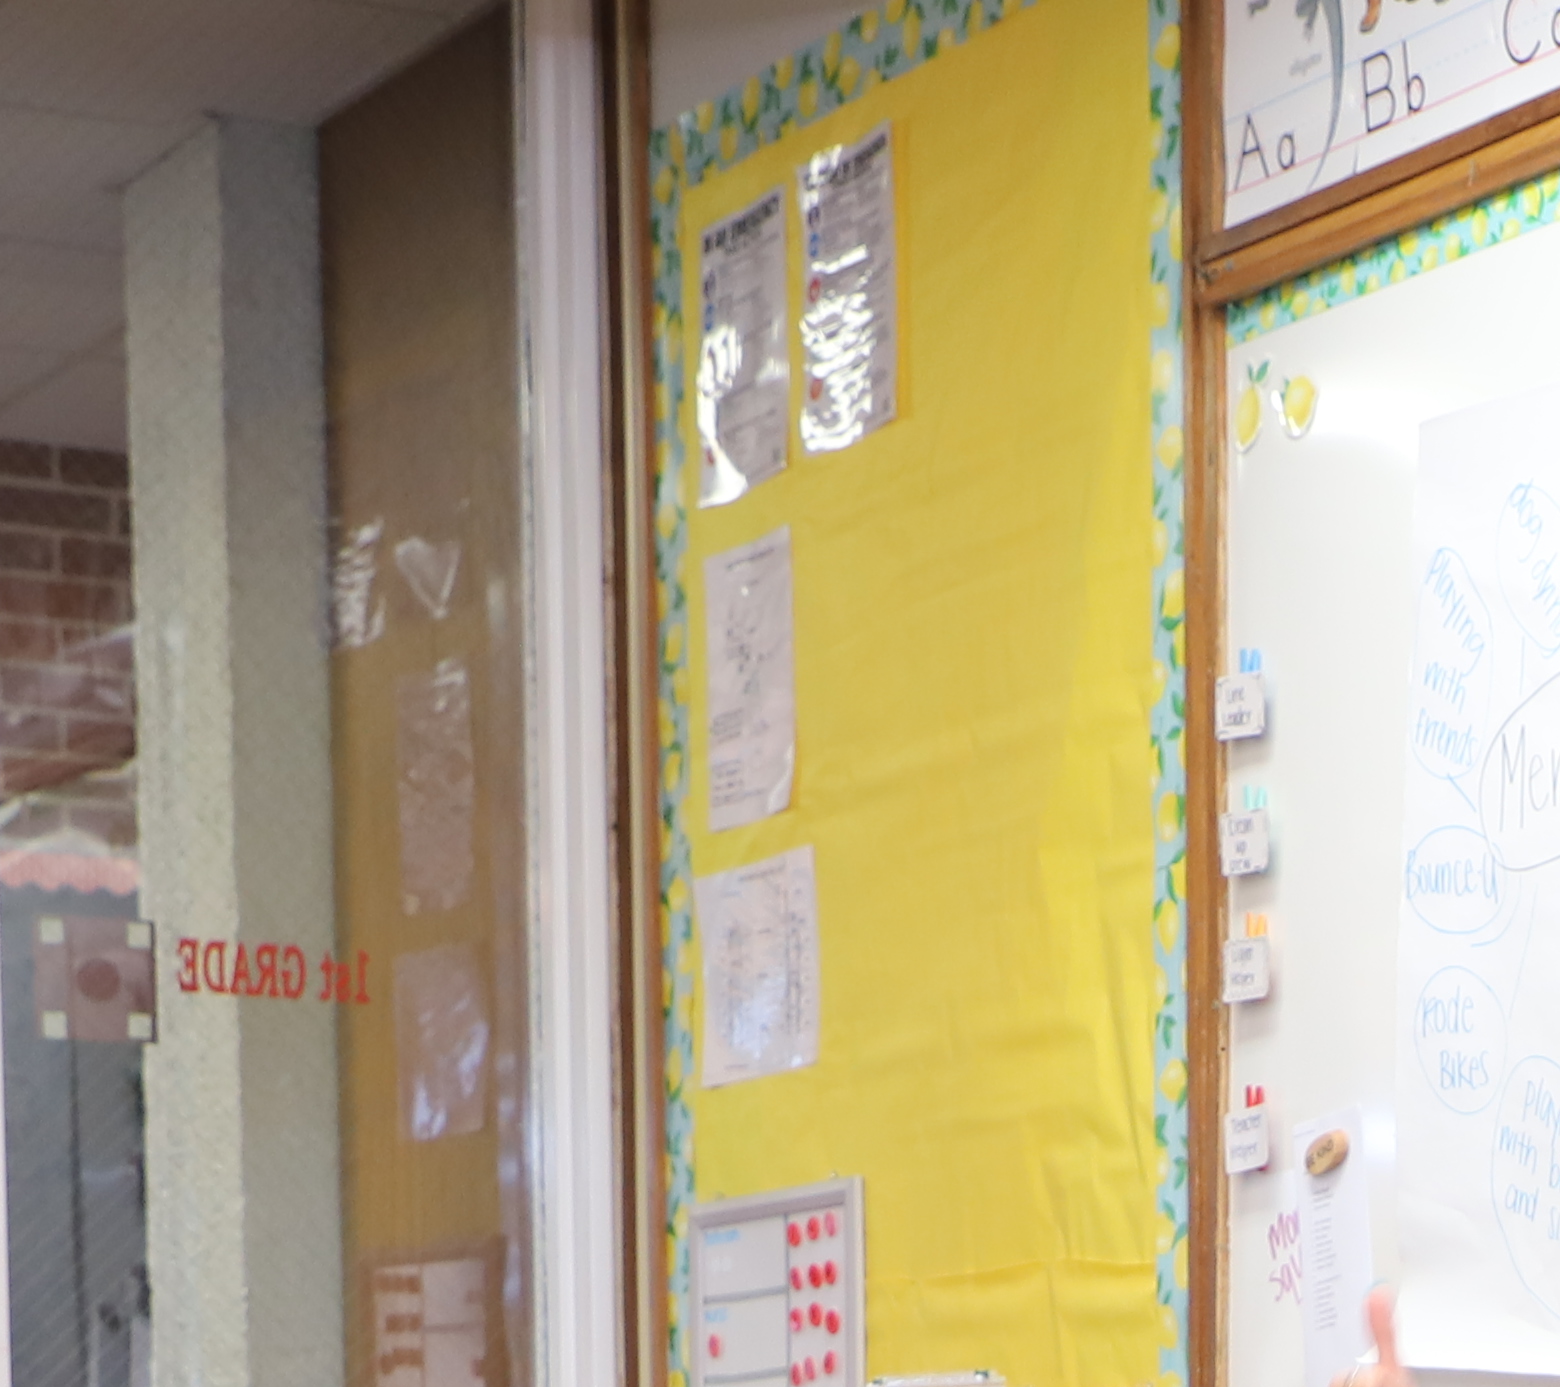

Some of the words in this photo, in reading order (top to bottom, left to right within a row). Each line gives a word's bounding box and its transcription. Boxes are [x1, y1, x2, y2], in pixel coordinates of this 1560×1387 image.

[1233, 114, 1297, 192] Aa
[1361, 40, 1427, 134] Bb
[1510, 478, 1543, 563] dog
[1424, 661, 1466, 714] with
[1500, 1123, 1538, 1174] with
[1504, 1183, 1538, 1221] and
